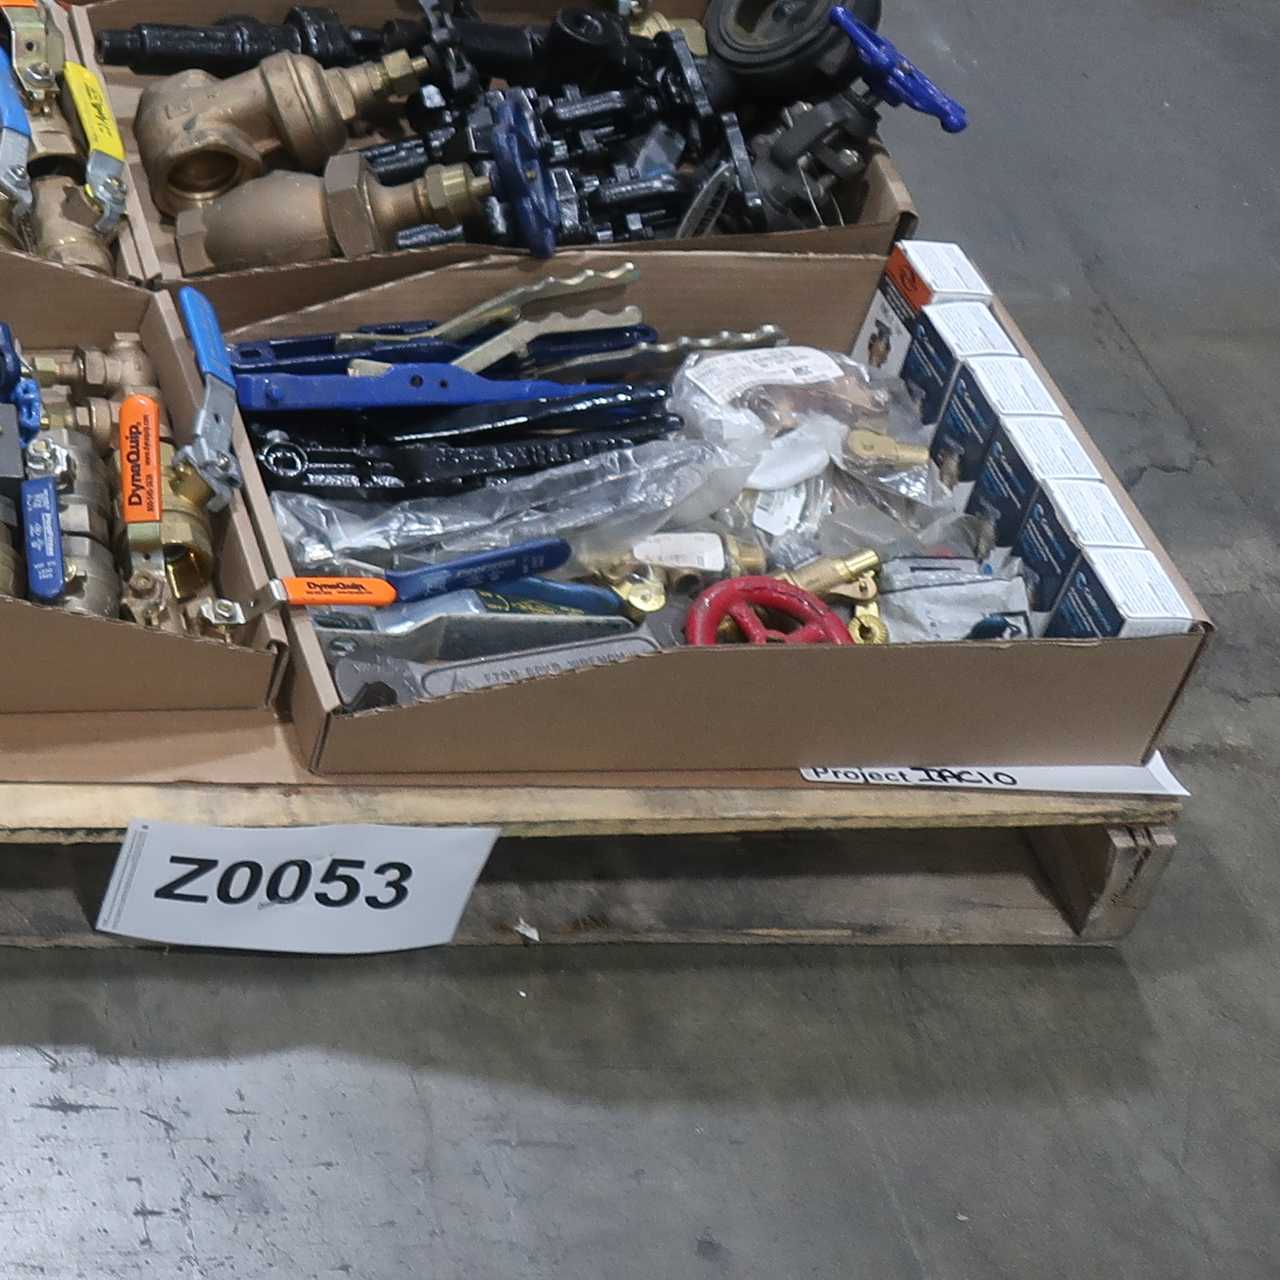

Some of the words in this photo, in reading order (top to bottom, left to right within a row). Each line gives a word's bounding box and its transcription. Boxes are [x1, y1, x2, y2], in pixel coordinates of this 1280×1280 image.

[126, 423, 143, 507] DynaQuip
[306, 581, 365, 592] DynaQuip
[811, 767, 912, 784] Project
[153, 855, 414, 910] Z0053
